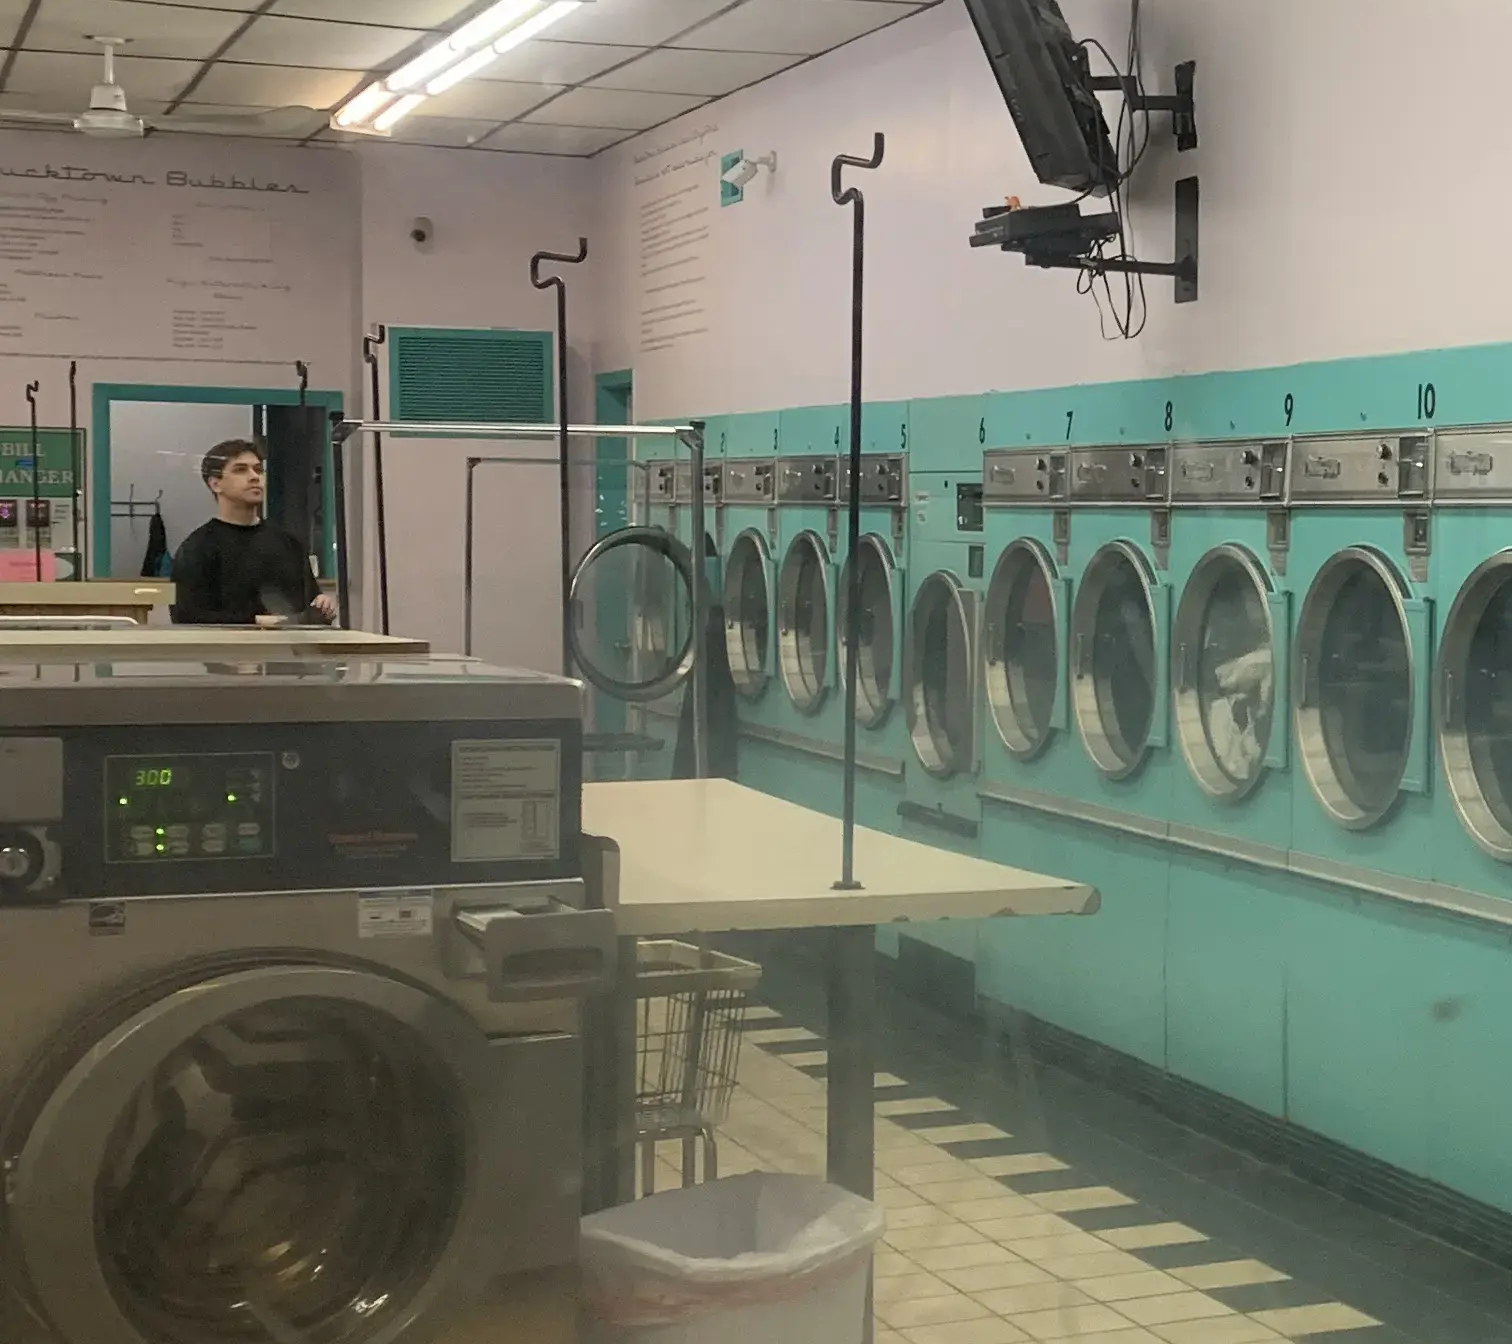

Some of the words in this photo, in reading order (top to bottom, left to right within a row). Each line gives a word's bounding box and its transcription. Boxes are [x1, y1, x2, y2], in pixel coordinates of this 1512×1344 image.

[0, 162, 156, 185] uckTown
[165, 170, 310, 194] Bubbles
[1284, 393, 1294, 427] 9
[1417, 382, 1436, 420] 10
[1066, 410, 1074, 441] 7
[1164, 400, 1173, 432] 8
[834, 426, 840, 449] 4
[900, 423, 907, 449] 5
[979, 417, 986, 445] 6
[0, 442, 46, 457] BILL
[135, 769, 173, 786] 300
